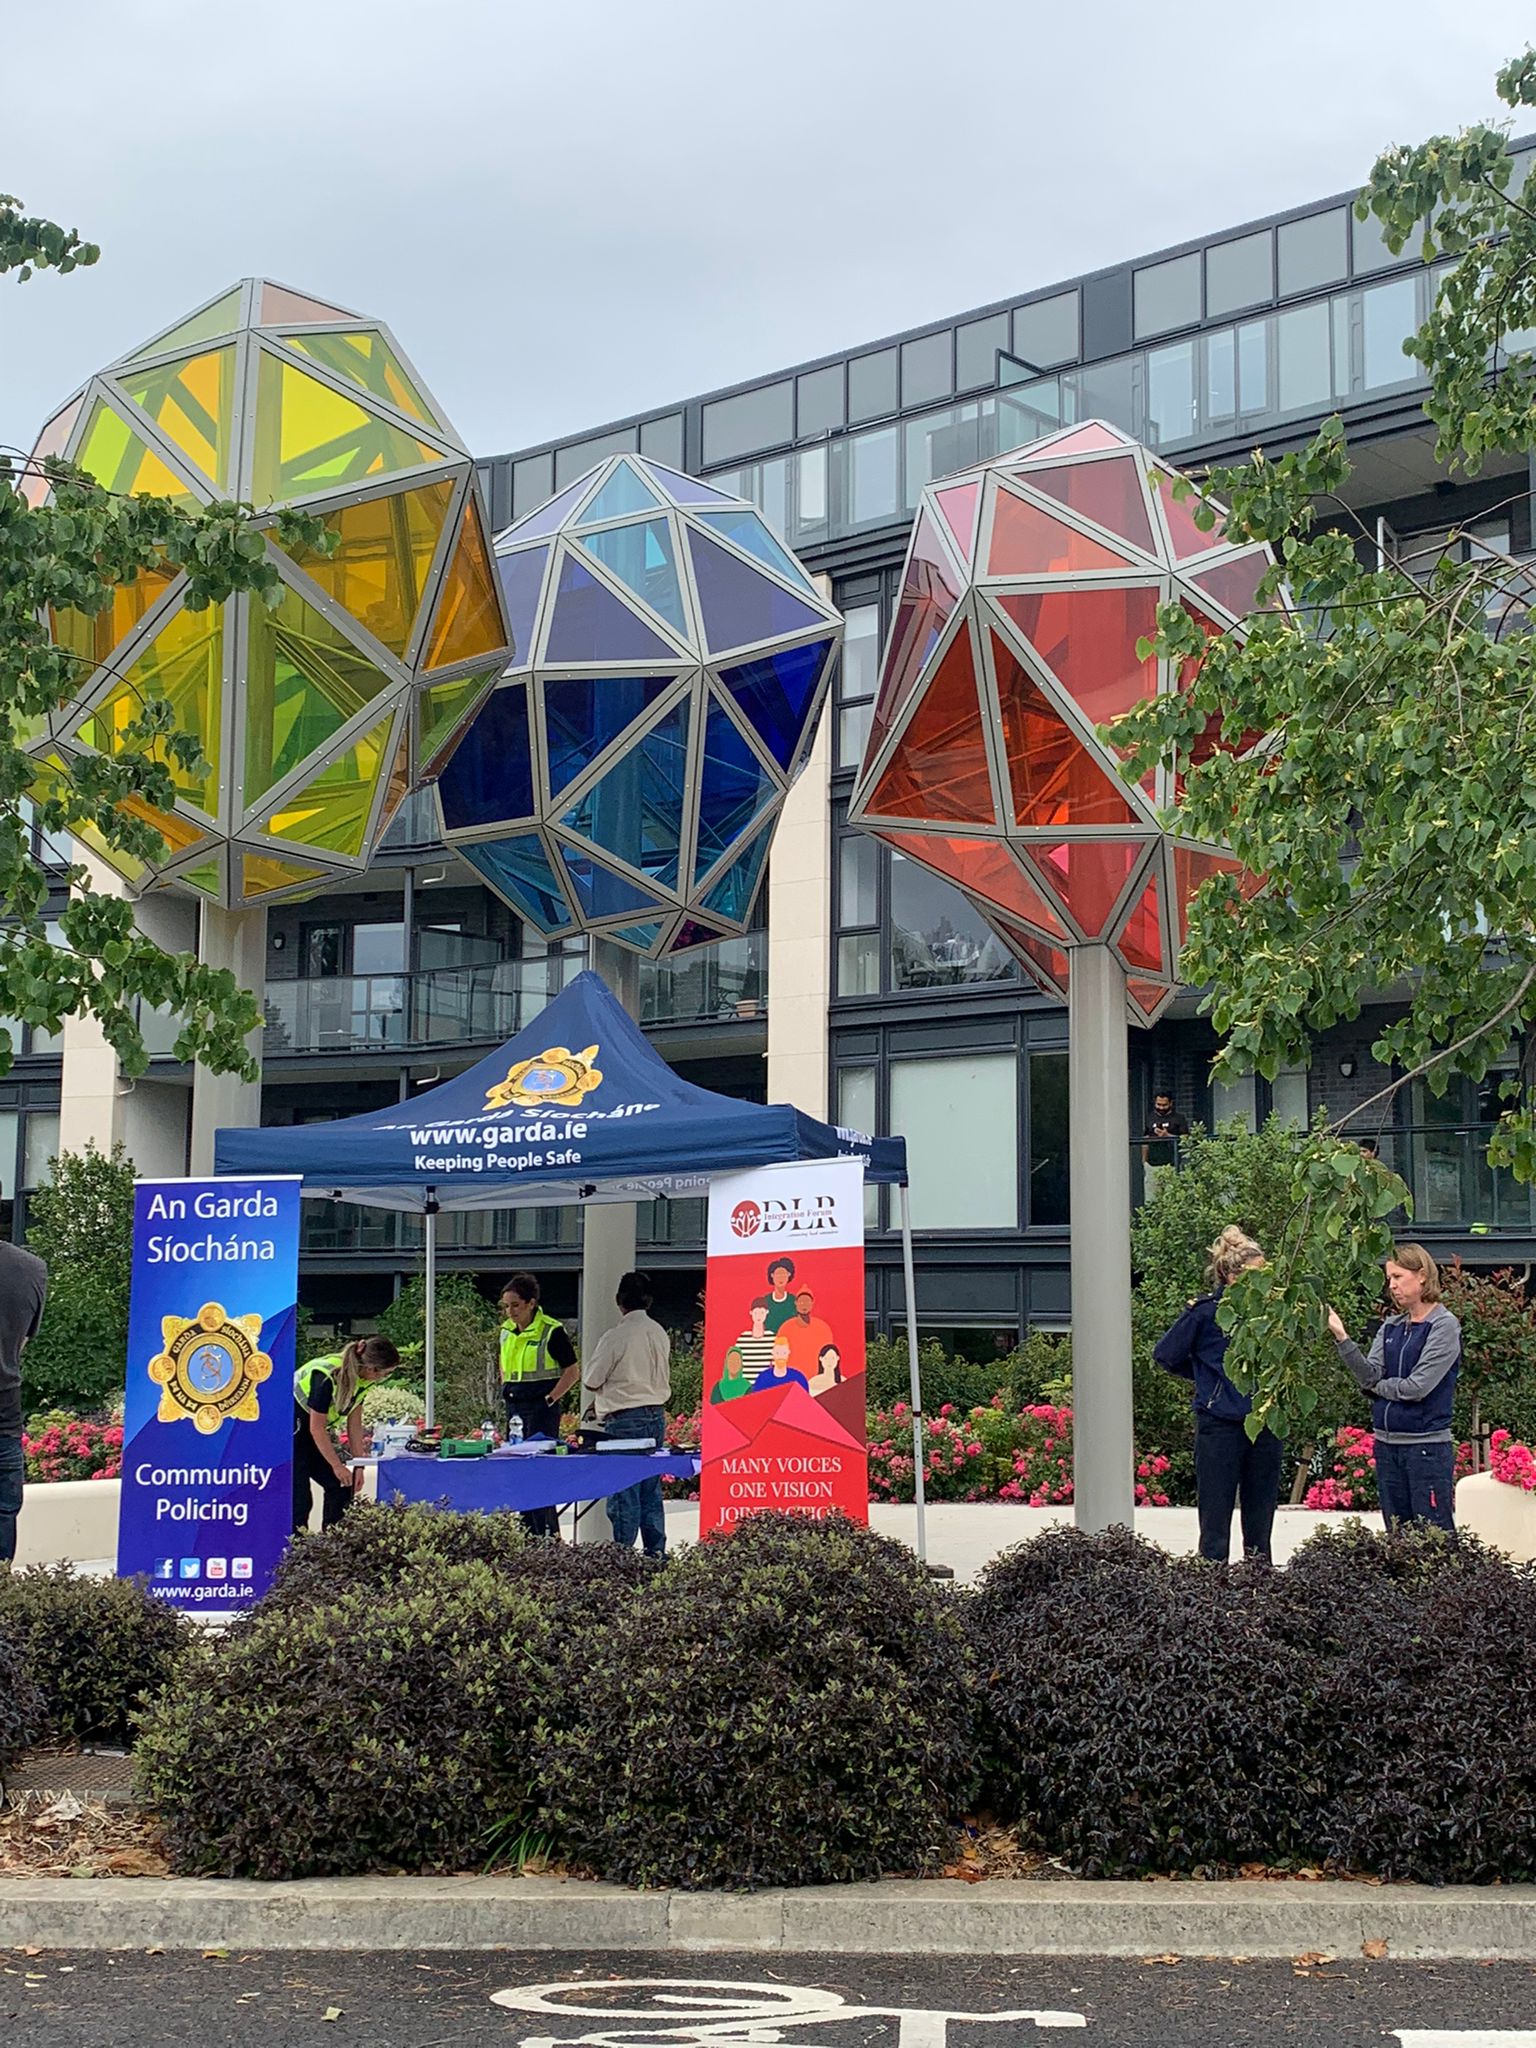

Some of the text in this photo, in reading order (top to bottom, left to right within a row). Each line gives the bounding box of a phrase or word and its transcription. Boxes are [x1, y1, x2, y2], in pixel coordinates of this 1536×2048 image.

[410, 1120, 588, 1149] www.garda.ie
[414, 1149, 582, 1172] Keeping People Safe
[147, 1189, 278, 1220] An Garda
[761, 1195, 838, 1233] DLR
[147, 1233, 275, 1263] Síochána
[135, 1463, 272, 1490] Community
[722, 1457, 842, 1474] MANY VOICES
[729, 1481, 833, 1498] ONE VISION
[156, 1497, 248, 1526] Policing
[152, 1583, 254, 1601] www.garda.ie
